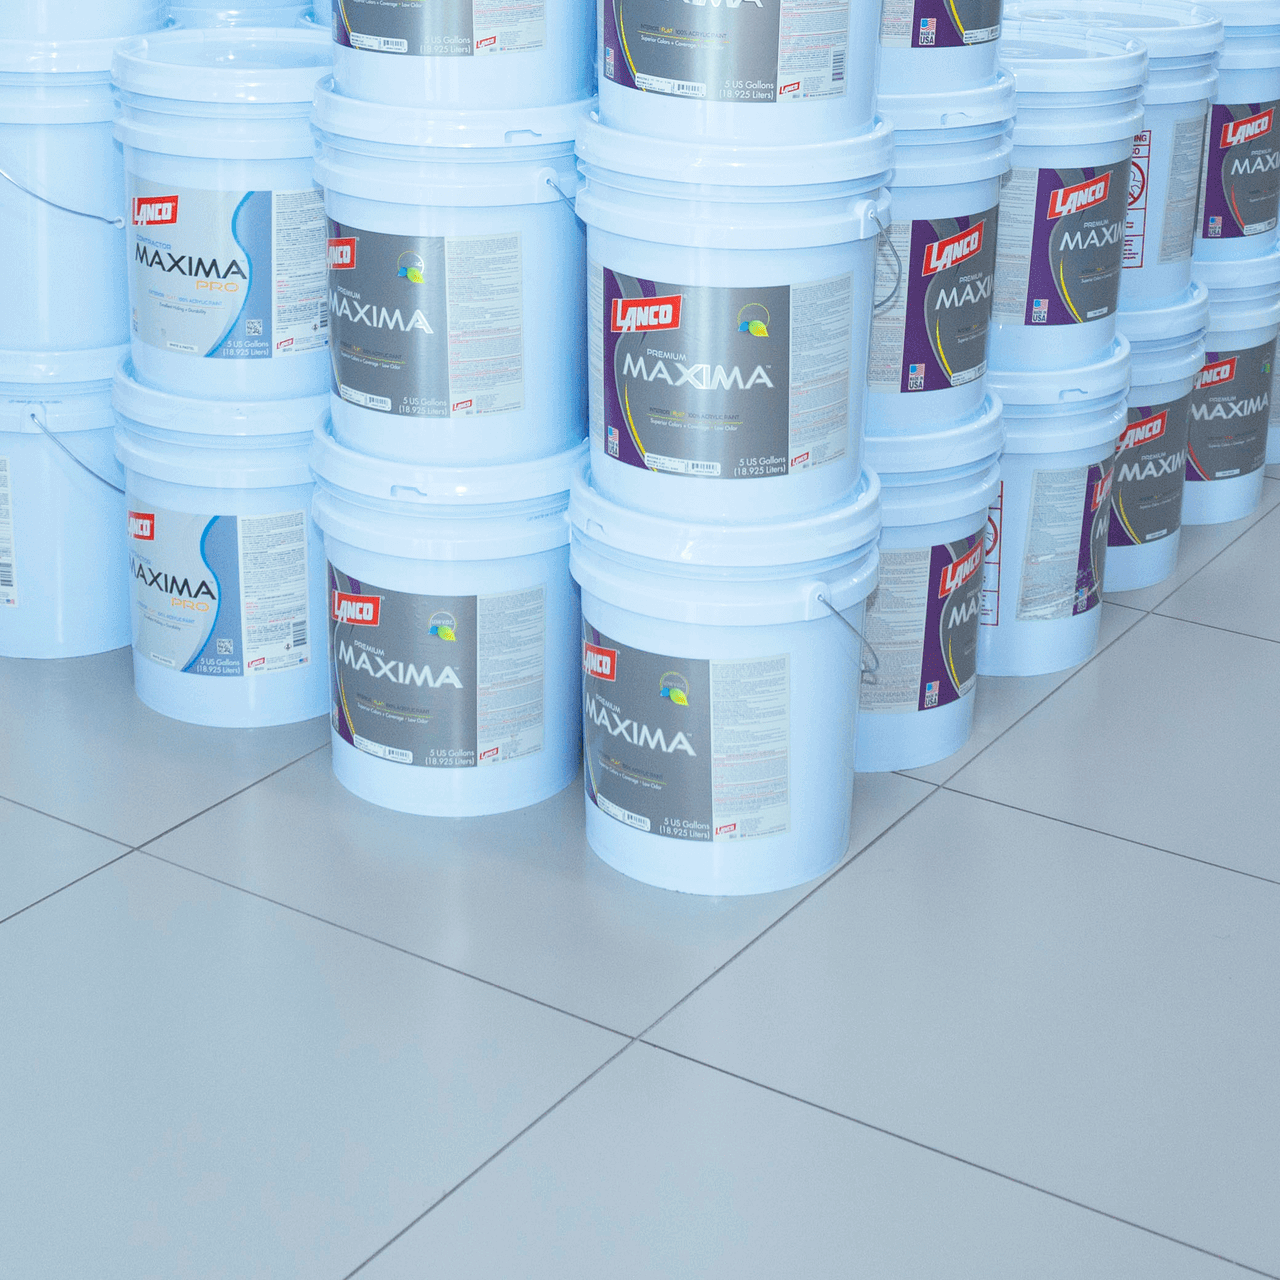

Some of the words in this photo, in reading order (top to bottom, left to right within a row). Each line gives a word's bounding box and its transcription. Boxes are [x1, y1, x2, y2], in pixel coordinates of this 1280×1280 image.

[641, 35, 656, 43] Superior
[675, 40, 697, 48] Coverage
[920, 36, 934, 44] USA
[450, 45, 470, 54] Liters)
[725, 81, 729, 89] 5
[732, 81, 746, 89] US
[748, 80, 774, 90] Gallons
[719, 89, 750, 98] (18.925
[752, 90, 774, 99] Liters)
[1228, 115, 1268, 144] LANCO
[1057, 182, 1105, 216] LANCO
[135, 198, 172, 225] LANCO
[1084, 219, 1109, 228] PREMIUM
[137, 234, 171, 250] CONTRACTOR
[931, 231, 978, 271] LANCO
[135, 242, 247, 279] MAXIMA
[959, 272, 982, 284] PREMIUM
[196, 280, 239, 292] PRO
[338, 286, 360, 299] PREMIUM
[329, 288, 434, 334] MAXIMA
[617, 304, 672, 331] LANCO
[223, 348, 249, 356] (18.925
[250, 348, 269, 356] Liters)
[647, 348, 687, 361] PREMIUM
[623, 353, 774, 390] MAXIMA
[1195, 364, 1230, 389] ANCO
[909, 380, 922, 389] USA
[421, 398, 447, 406] Gallons
[1192, 393, 1268, 420] MAXIMA
[399, 405, 425, 414] (18.925
[427, 406, 447, 415] Liters)
[608, 446, 618, 456] USA
[1141, 452, 1166, 460] PREMIUM
[739, 458, 744, 466] 5
[747, 458, 758, 466] US
[760, 456, 786, 466] Gallons
[1118, 449, 1186, 482] MAXIM
[734, 467, 764, 476] (18.925
[766, 465, 786, 474] Liters)
[947, 543, 983, 589] LANCO
[129, 555, 216, 600] MAXIMA
[171, 598, 209, 612] PRO
[335, 592, 373, 622] LANCO
[355, 640, 385, 656] PREMIUM
[196, 665, 220, 674] (18.925
[222, 666, 240, 674] Liters)
[339, 640, 463, 688] MAXIMA
[596, 694, 621, 714] PREMIUM
[926, 698, 937, 706] USA
[586, 692, 697, 756] MAXIMA
[436, 749, 447, 757] US
[448, 749, 474, 758] Gallons
[455, 758, 474, 766] Liters)
[664, 817, 669, 825] 5
[683, 820, 710, 830] Gallons
[660, 825, 688, 836] (18.925
[690, 829, 710, 839] Liters)
